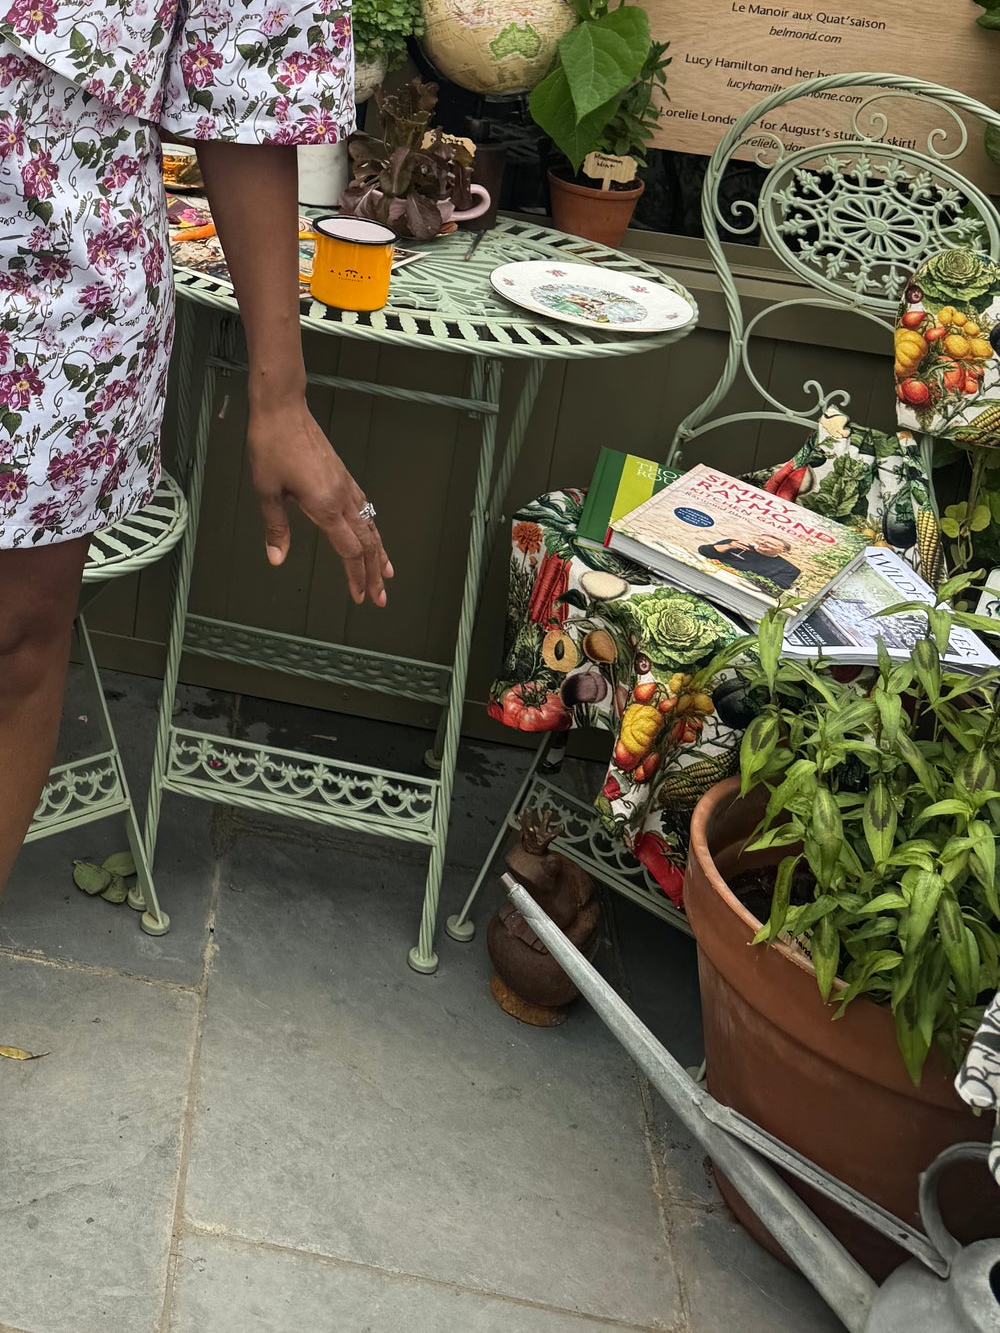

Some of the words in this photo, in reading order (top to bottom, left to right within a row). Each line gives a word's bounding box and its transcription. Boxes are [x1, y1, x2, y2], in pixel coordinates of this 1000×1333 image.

[731, 2, 746, 13] Le
[748, 4, 790, 18] Manoir
[792, 11, 813, 21] aux
[769, 26, 842, 44] belmond.com
[685, 53, 713, 68] Lucy
[715, 57, 768, 73] Hamilton
[771, 65, 793, 77] and
[795, 67, 814, 79] her
[660, 106, 699, 121] Lorelie
[701, 112, 737, 125] Londo
[760, 120, 778, 131] for
[781, 123, 830, 138] August's
[887, 137, 916, 150] skirt!
[636, 461, 682, 479] THO
[705, 474, 797, 513] SIMPLY
[690, 487, 752, 516] KITCHEN
[757, 515, 817, 545] GARDEN
[696, 480, 836, 544] RAYMOND
